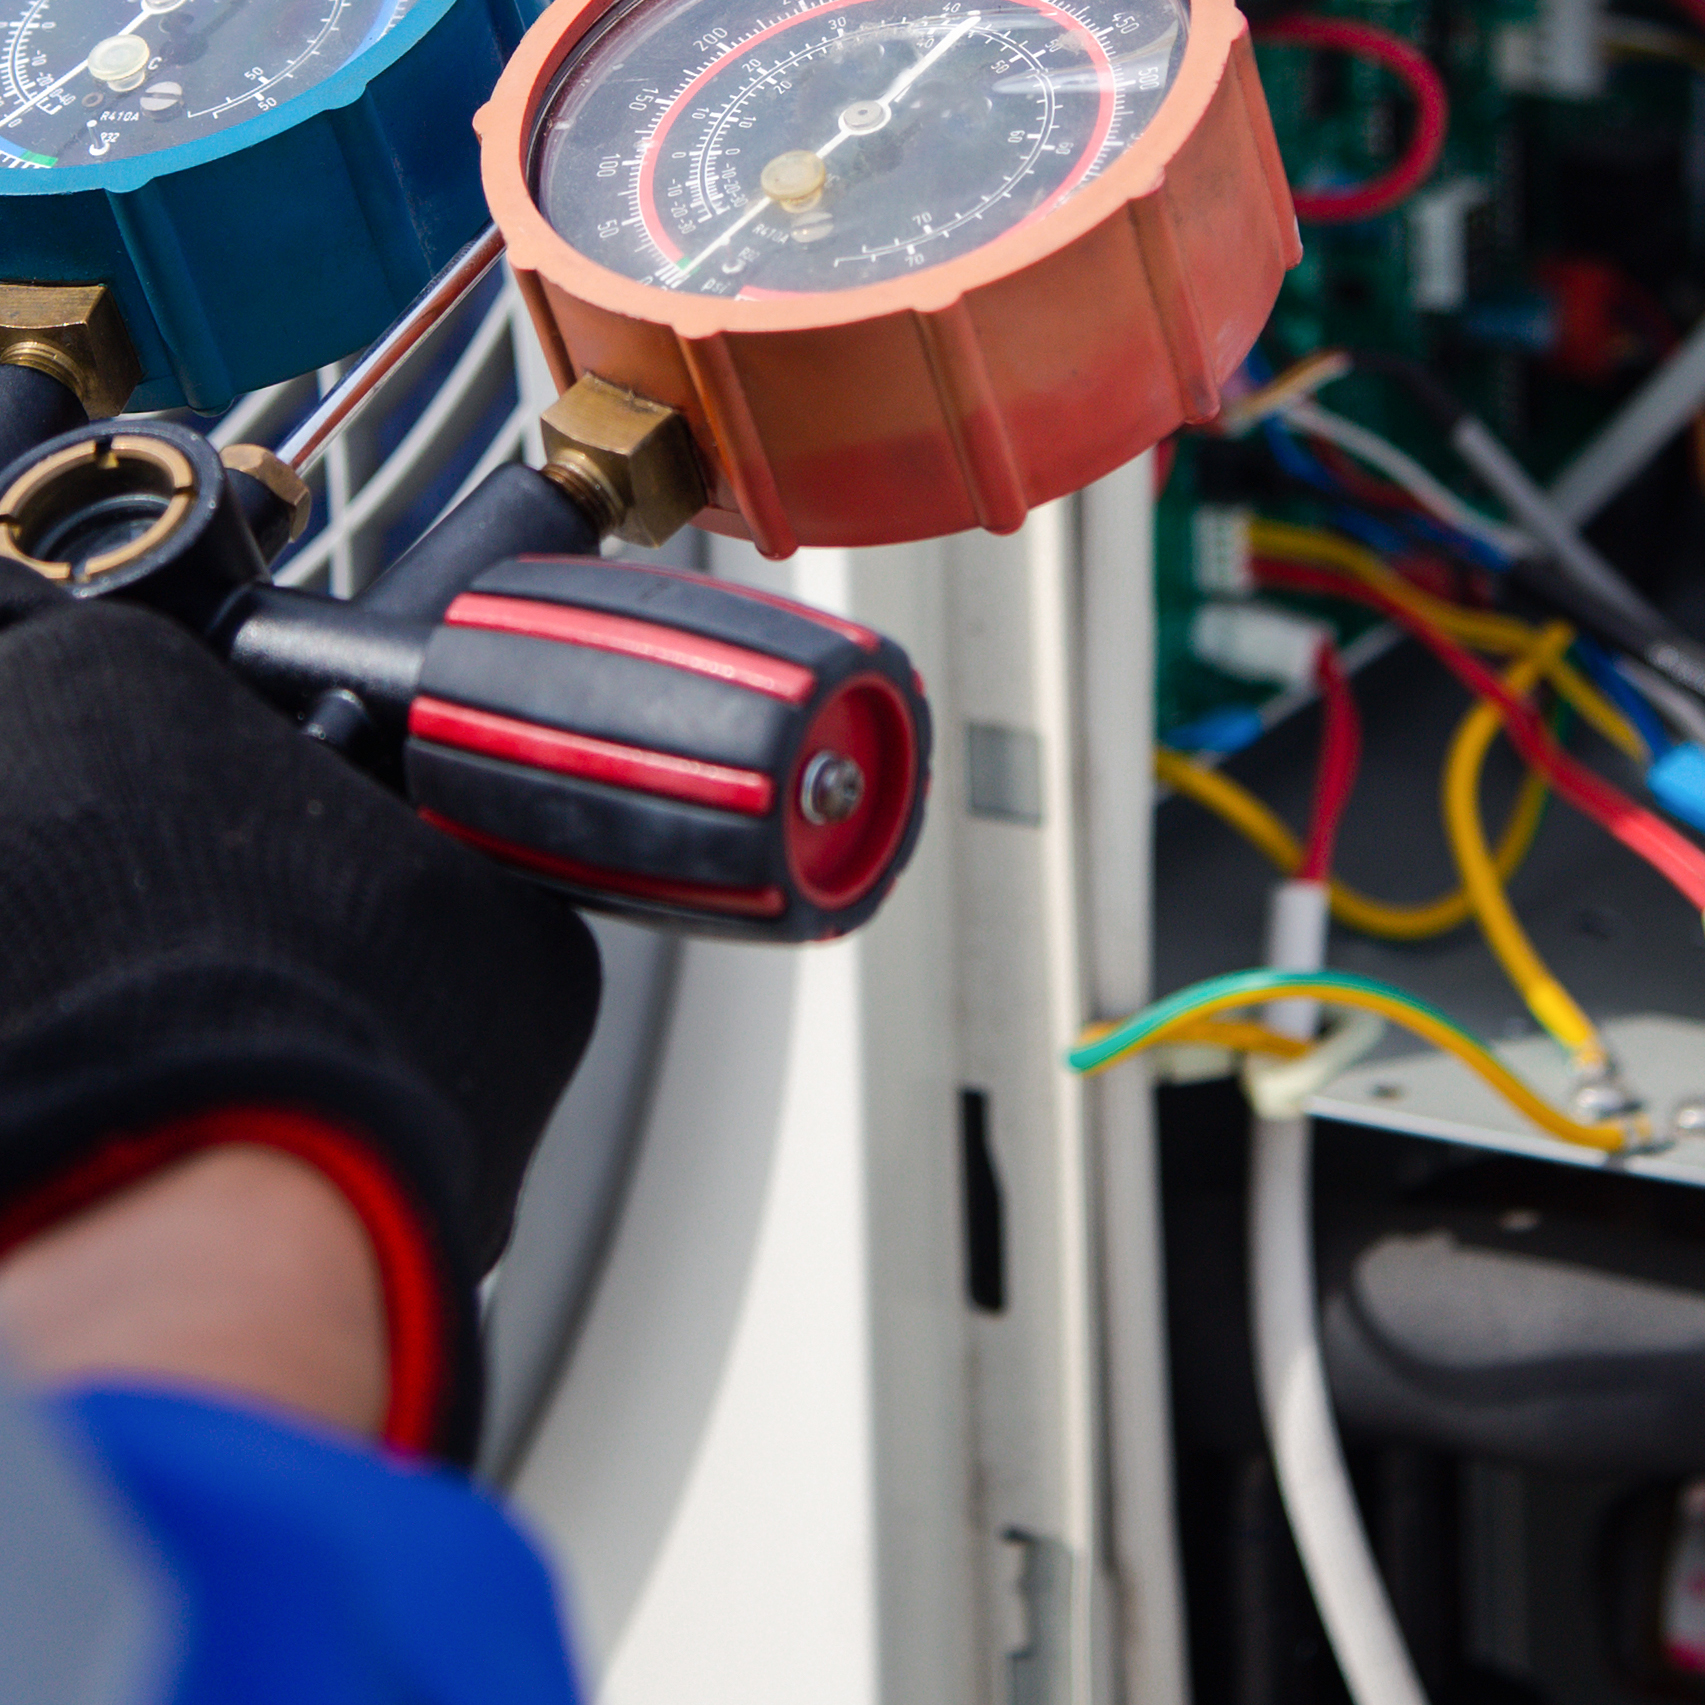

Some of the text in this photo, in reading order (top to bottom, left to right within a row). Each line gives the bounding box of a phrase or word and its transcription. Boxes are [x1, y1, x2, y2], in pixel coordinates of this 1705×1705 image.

[942, 2, 961, 13] 40
[41, 21, 56, 29] 0
[828, 16, 846, 29] 30
[1111, 11, 1139, 34] 450
[692, 27, 728, 51] 200
[916, 37, 934, 48] 40
[31, 49, 47, 66] -10
[741, 58, 761, 72] 20
[243, 66, 264, 80] 50
[990, 59, 1009, 74] 50
[1138, 66, 1159, 90] 500
[772, 80, 792, 94] 20
[257, 97, 277, 111] 50
[628, 87, 658, 110] 150
[99, 110, 139, 121] R410A
[691, 106, 709, 119] 10
[738, 115, 756, 128] 10
[1007, 129, 1025, 143] 60
[596, 152, 620, 177] 100
[721, 162, 736, 178] -10
[667, 178, 682, 196] -10
[723, 178, 740, 193] -20
[670, 201, 688, 218] -20
[678, 218, 696, 234] -30
[911, 211, 932, 226] 70
[597, 218, 619, 238] 50
[751, 222, 789, 244] R410A
[904, 252, 925, 267] 70
[700, 276, 731, 294] psi
